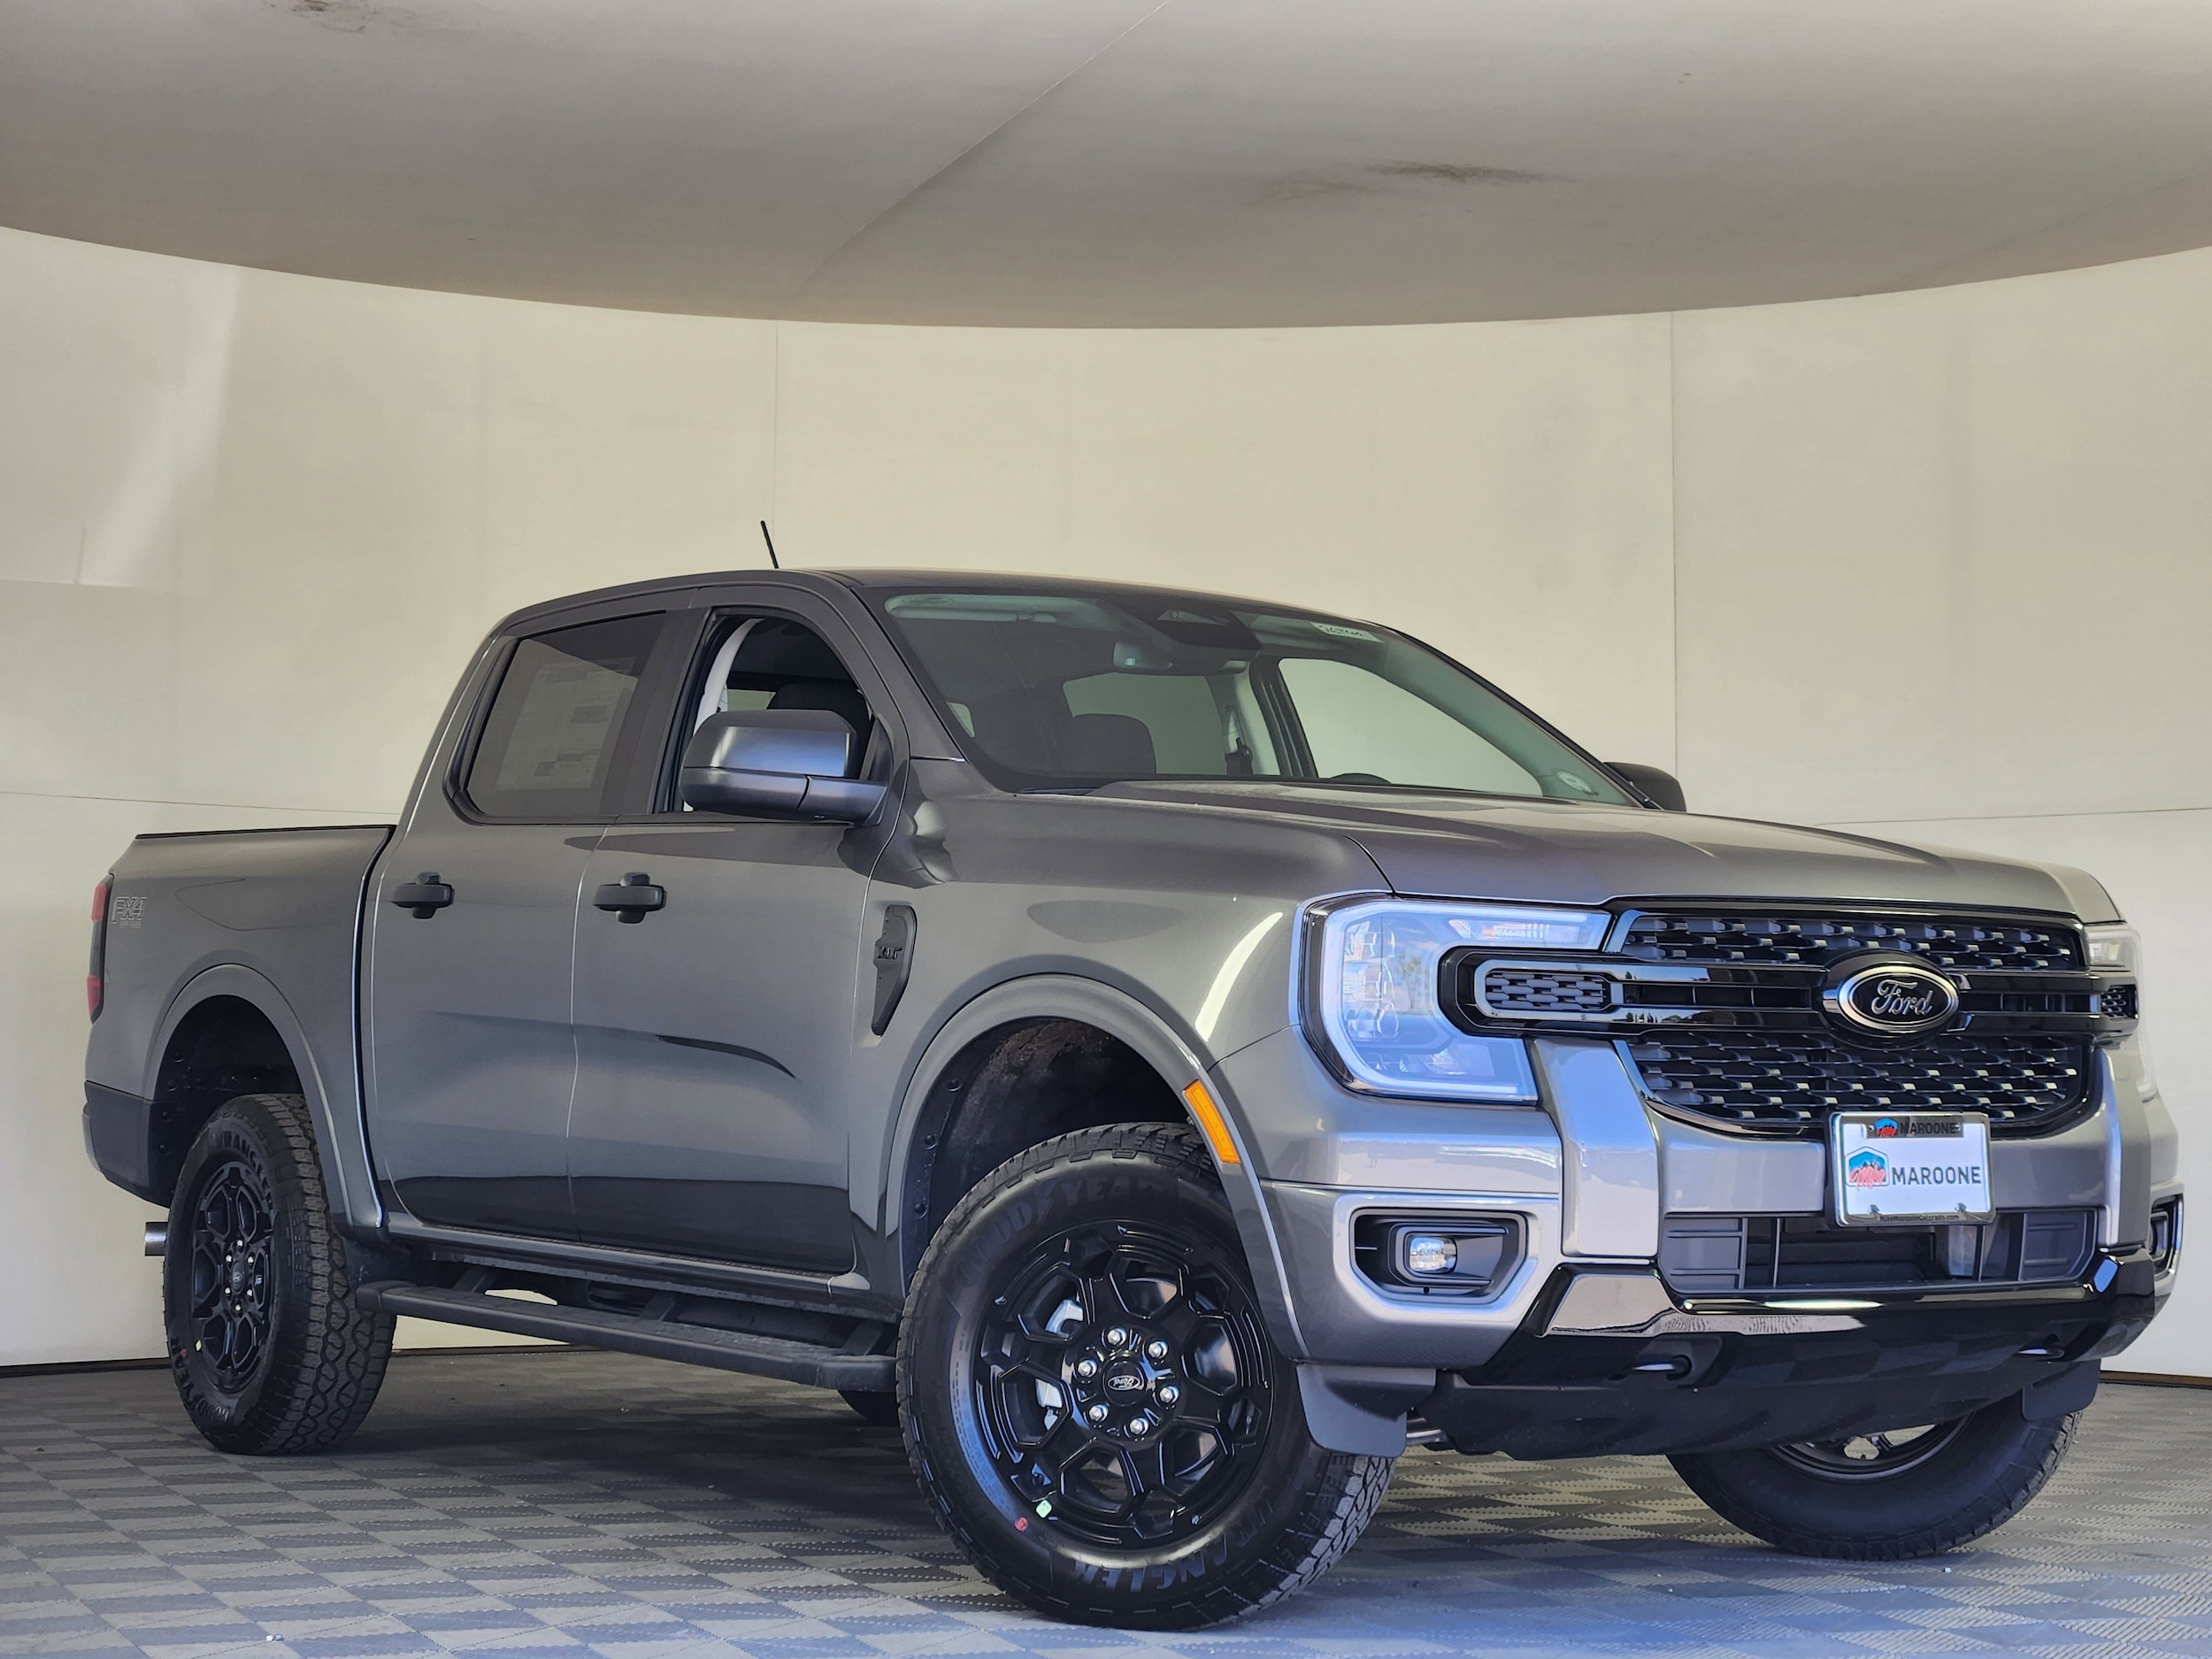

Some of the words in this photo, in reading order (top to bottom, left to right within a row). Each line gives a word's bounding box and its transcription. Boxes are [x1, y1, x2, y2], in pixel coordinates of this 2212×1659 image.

[111, 895, 148, 924] FX4
[1871, 979, 1934, 1016] Ford
[1901, 1122, 1958, 1134] MAROONE
[1892, 1166, 1982, 1186] MAROONE
